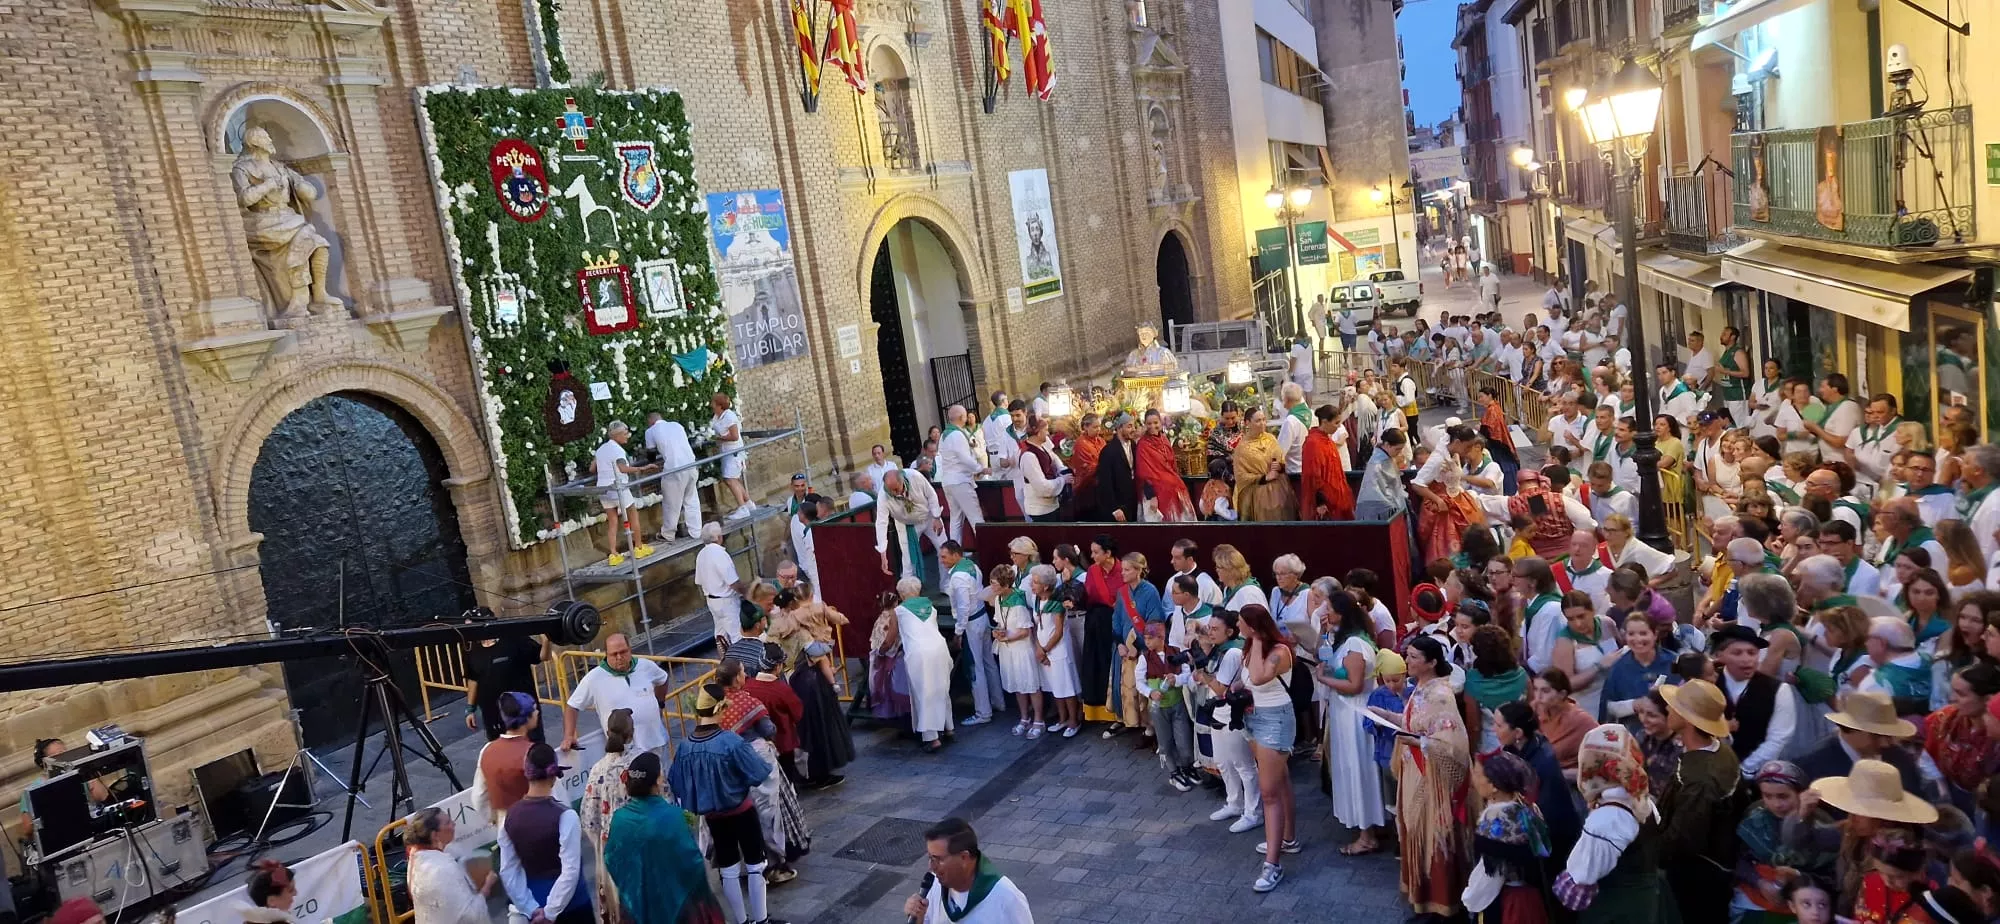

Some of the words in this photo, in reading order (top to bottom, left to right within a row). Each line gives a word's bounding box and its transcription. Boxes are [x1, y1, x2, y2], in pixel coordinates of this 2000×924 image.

[519, 184, 529, 192] LA
[1300, 237, 1313, 245] San
[1300, 243, 1327, 252] Lorenzo
[586, 267, 621, 277] RECREATIVA
[581, 279, 593, 312] PEÑA
[734, 314, 798, 338] TEMPLO
[740, 333, 803, 360] JUBILAR
